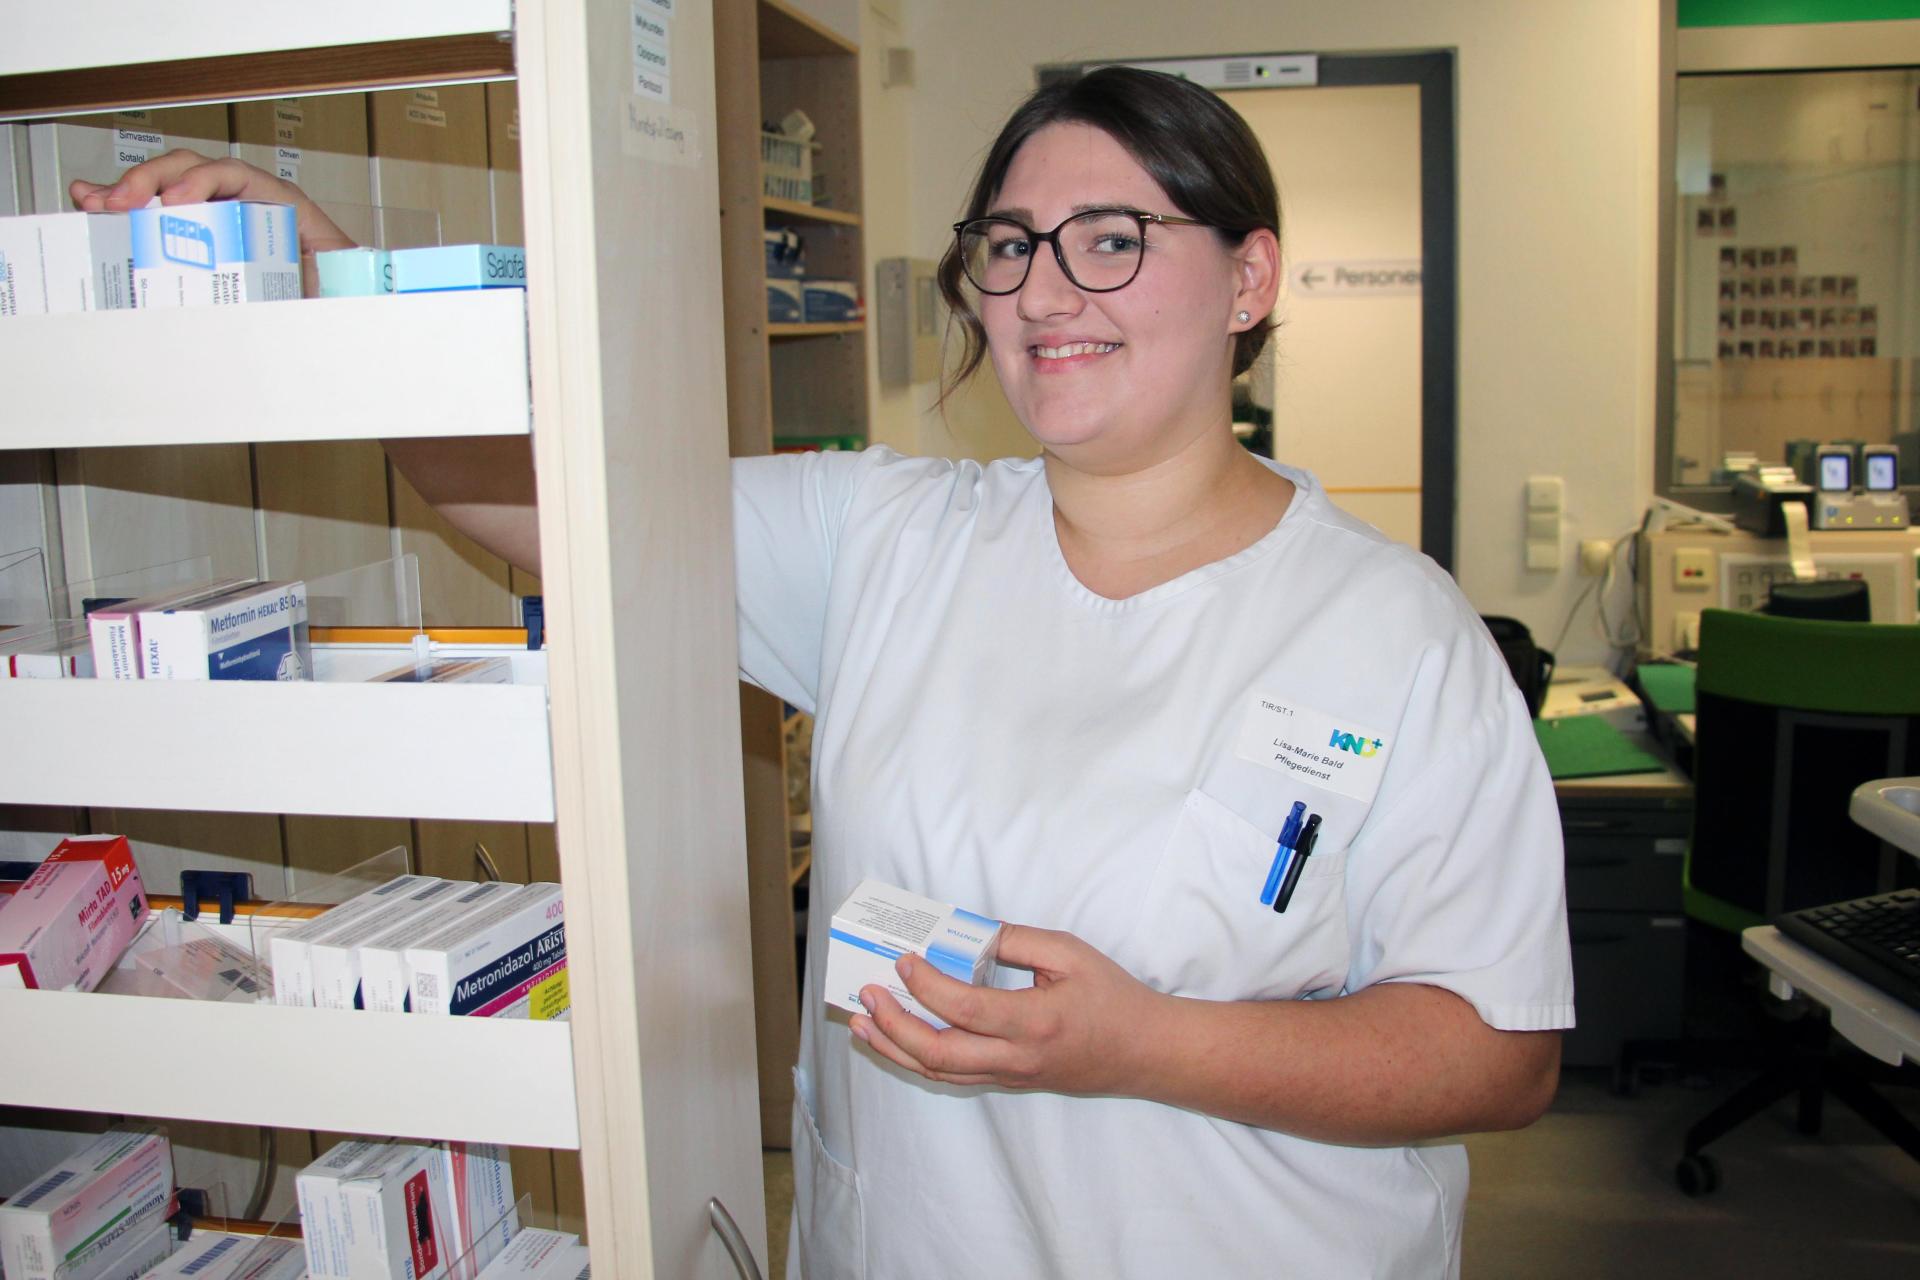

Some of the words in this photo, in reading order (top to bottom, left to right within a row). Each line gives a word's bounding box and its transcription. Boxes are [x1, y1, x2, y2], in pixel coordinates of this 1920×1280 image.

[119, 129, 162, 144] Simvastatin
[211, 606, 256, 634] Metformin
[119, 625, 129, 671] Metformin
[1273, 738, 1319, 761] Lisa-Marie
[1321, 756, 1344, 770] Bald
[1274, 753, 1331, 781] Pflegedienst
[110, 866, 122, 885] 15
[78, 900, 98, 927] Mirta
[95, 881, 111, 903] TAD
[545, 900, 564, 920] 400
[947, 928, 984, 944] ZENTIVA
[457, 943, 534, 1002] Metronidazol
